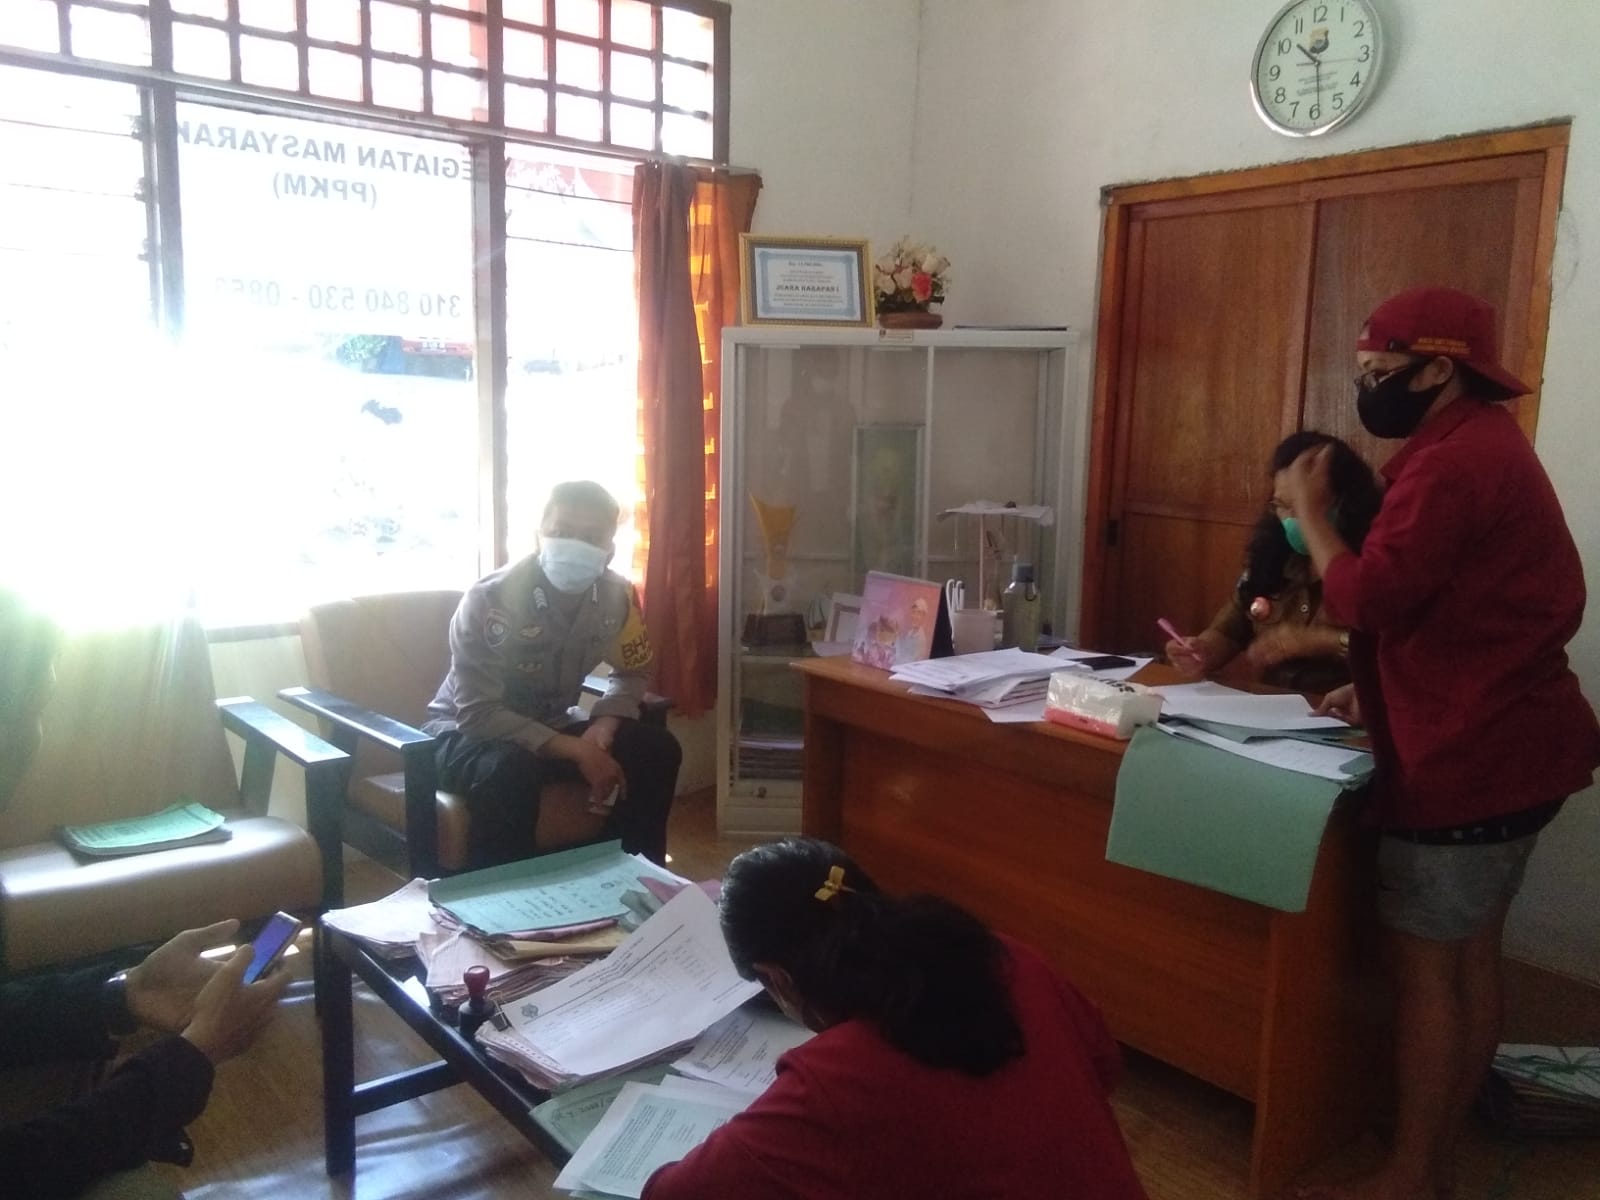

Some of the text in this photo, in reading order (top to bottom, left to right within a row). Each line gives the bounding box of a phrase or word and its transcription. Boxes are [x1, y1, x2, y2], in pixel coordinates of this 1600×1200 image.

[1313, 5, 1328, 23] 12
[1353, 20, 1364, 38] 2
[1277, 38, 1292, 56] 10
[1358, 45, 1370, 62] 3
[1269, 65, 1280, 81] 9
[1350, 71, 1361, 87] 4
[1274, 87, 1286, 104] 8
[1332, 92, 1344, 110] 5
[1289, 102, 1299, 118] 7
[1309, 103, 1320, 120] 6
